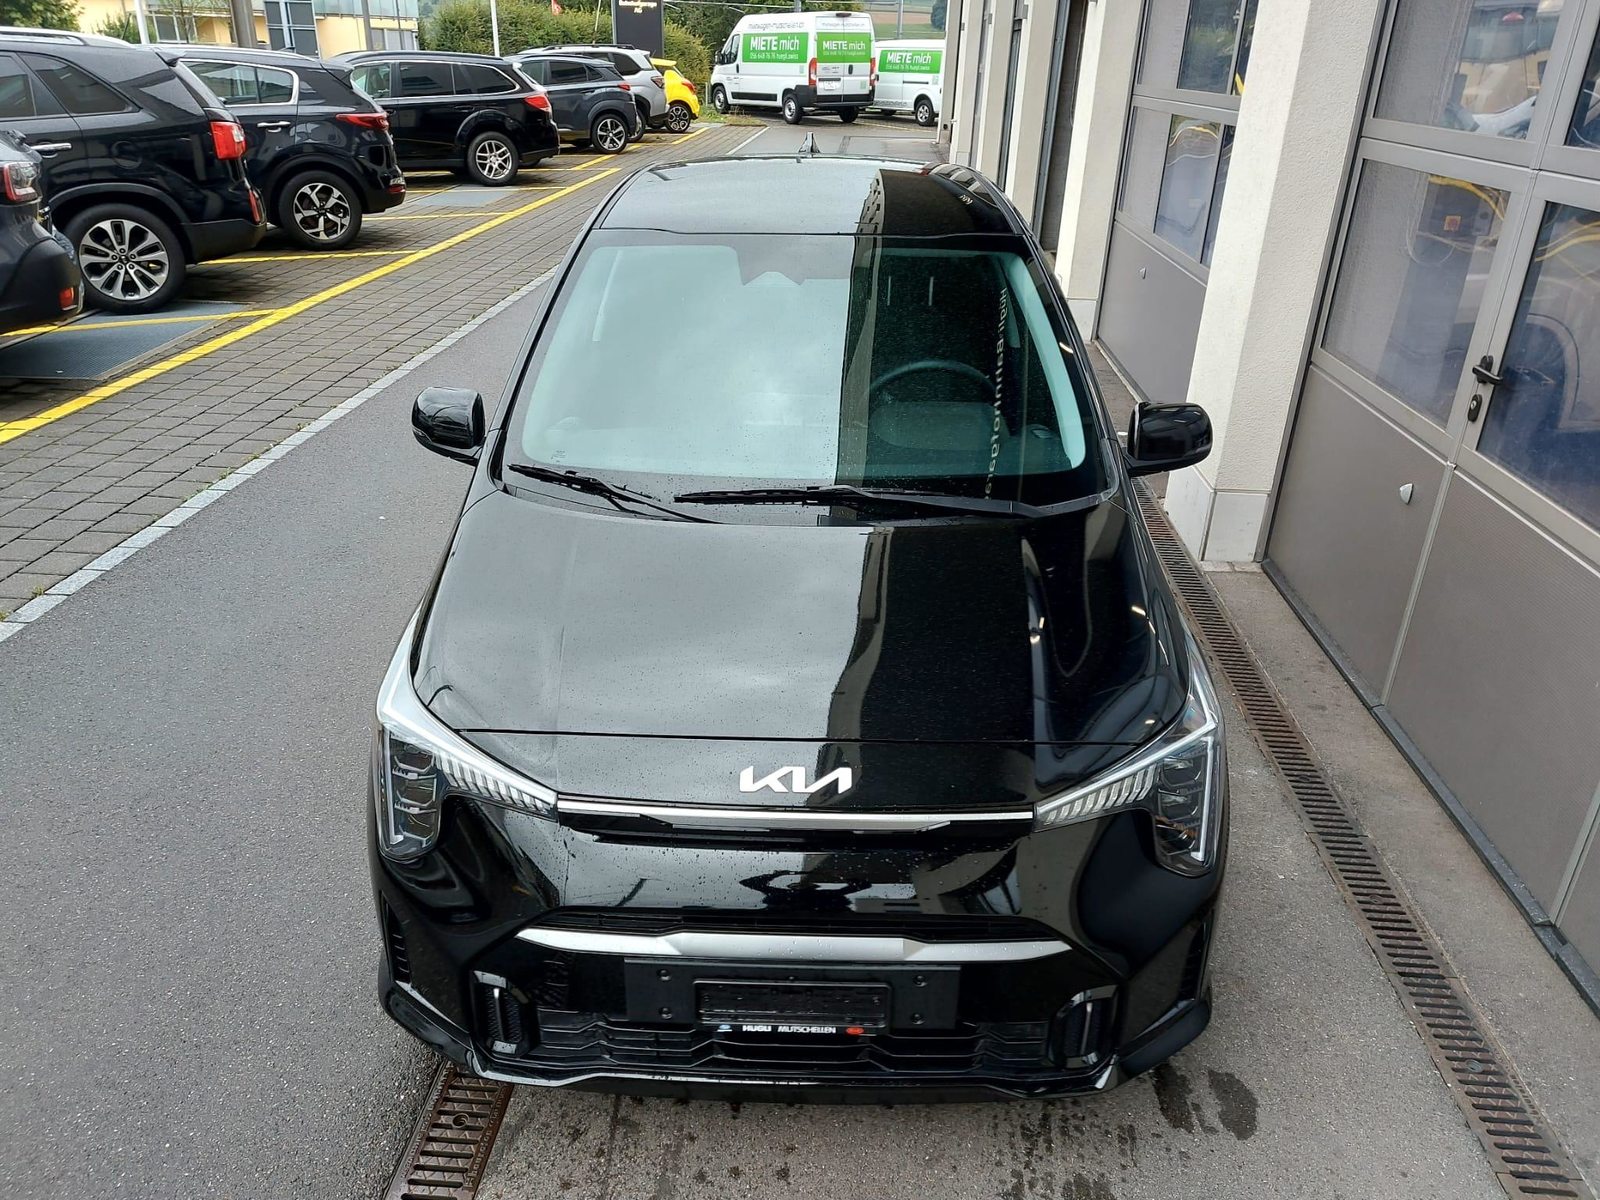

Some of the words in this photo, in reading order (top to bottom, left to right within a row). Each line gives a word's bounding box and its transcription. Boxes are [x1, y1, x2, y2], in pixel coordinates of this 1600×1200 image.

[750, 36, 778, 50] MIETE
[779, 36, 800, 50] mich
[823, 40, 848, 50] MIETE
[848, 40, 866, 50] mich
[887, 52, 912, 64] MIETE
[913, 52, 932, 64] mich
[739, 765, 853, 795] KIA
[777, 1025, 837, 1034] MUTSCHELLEN
